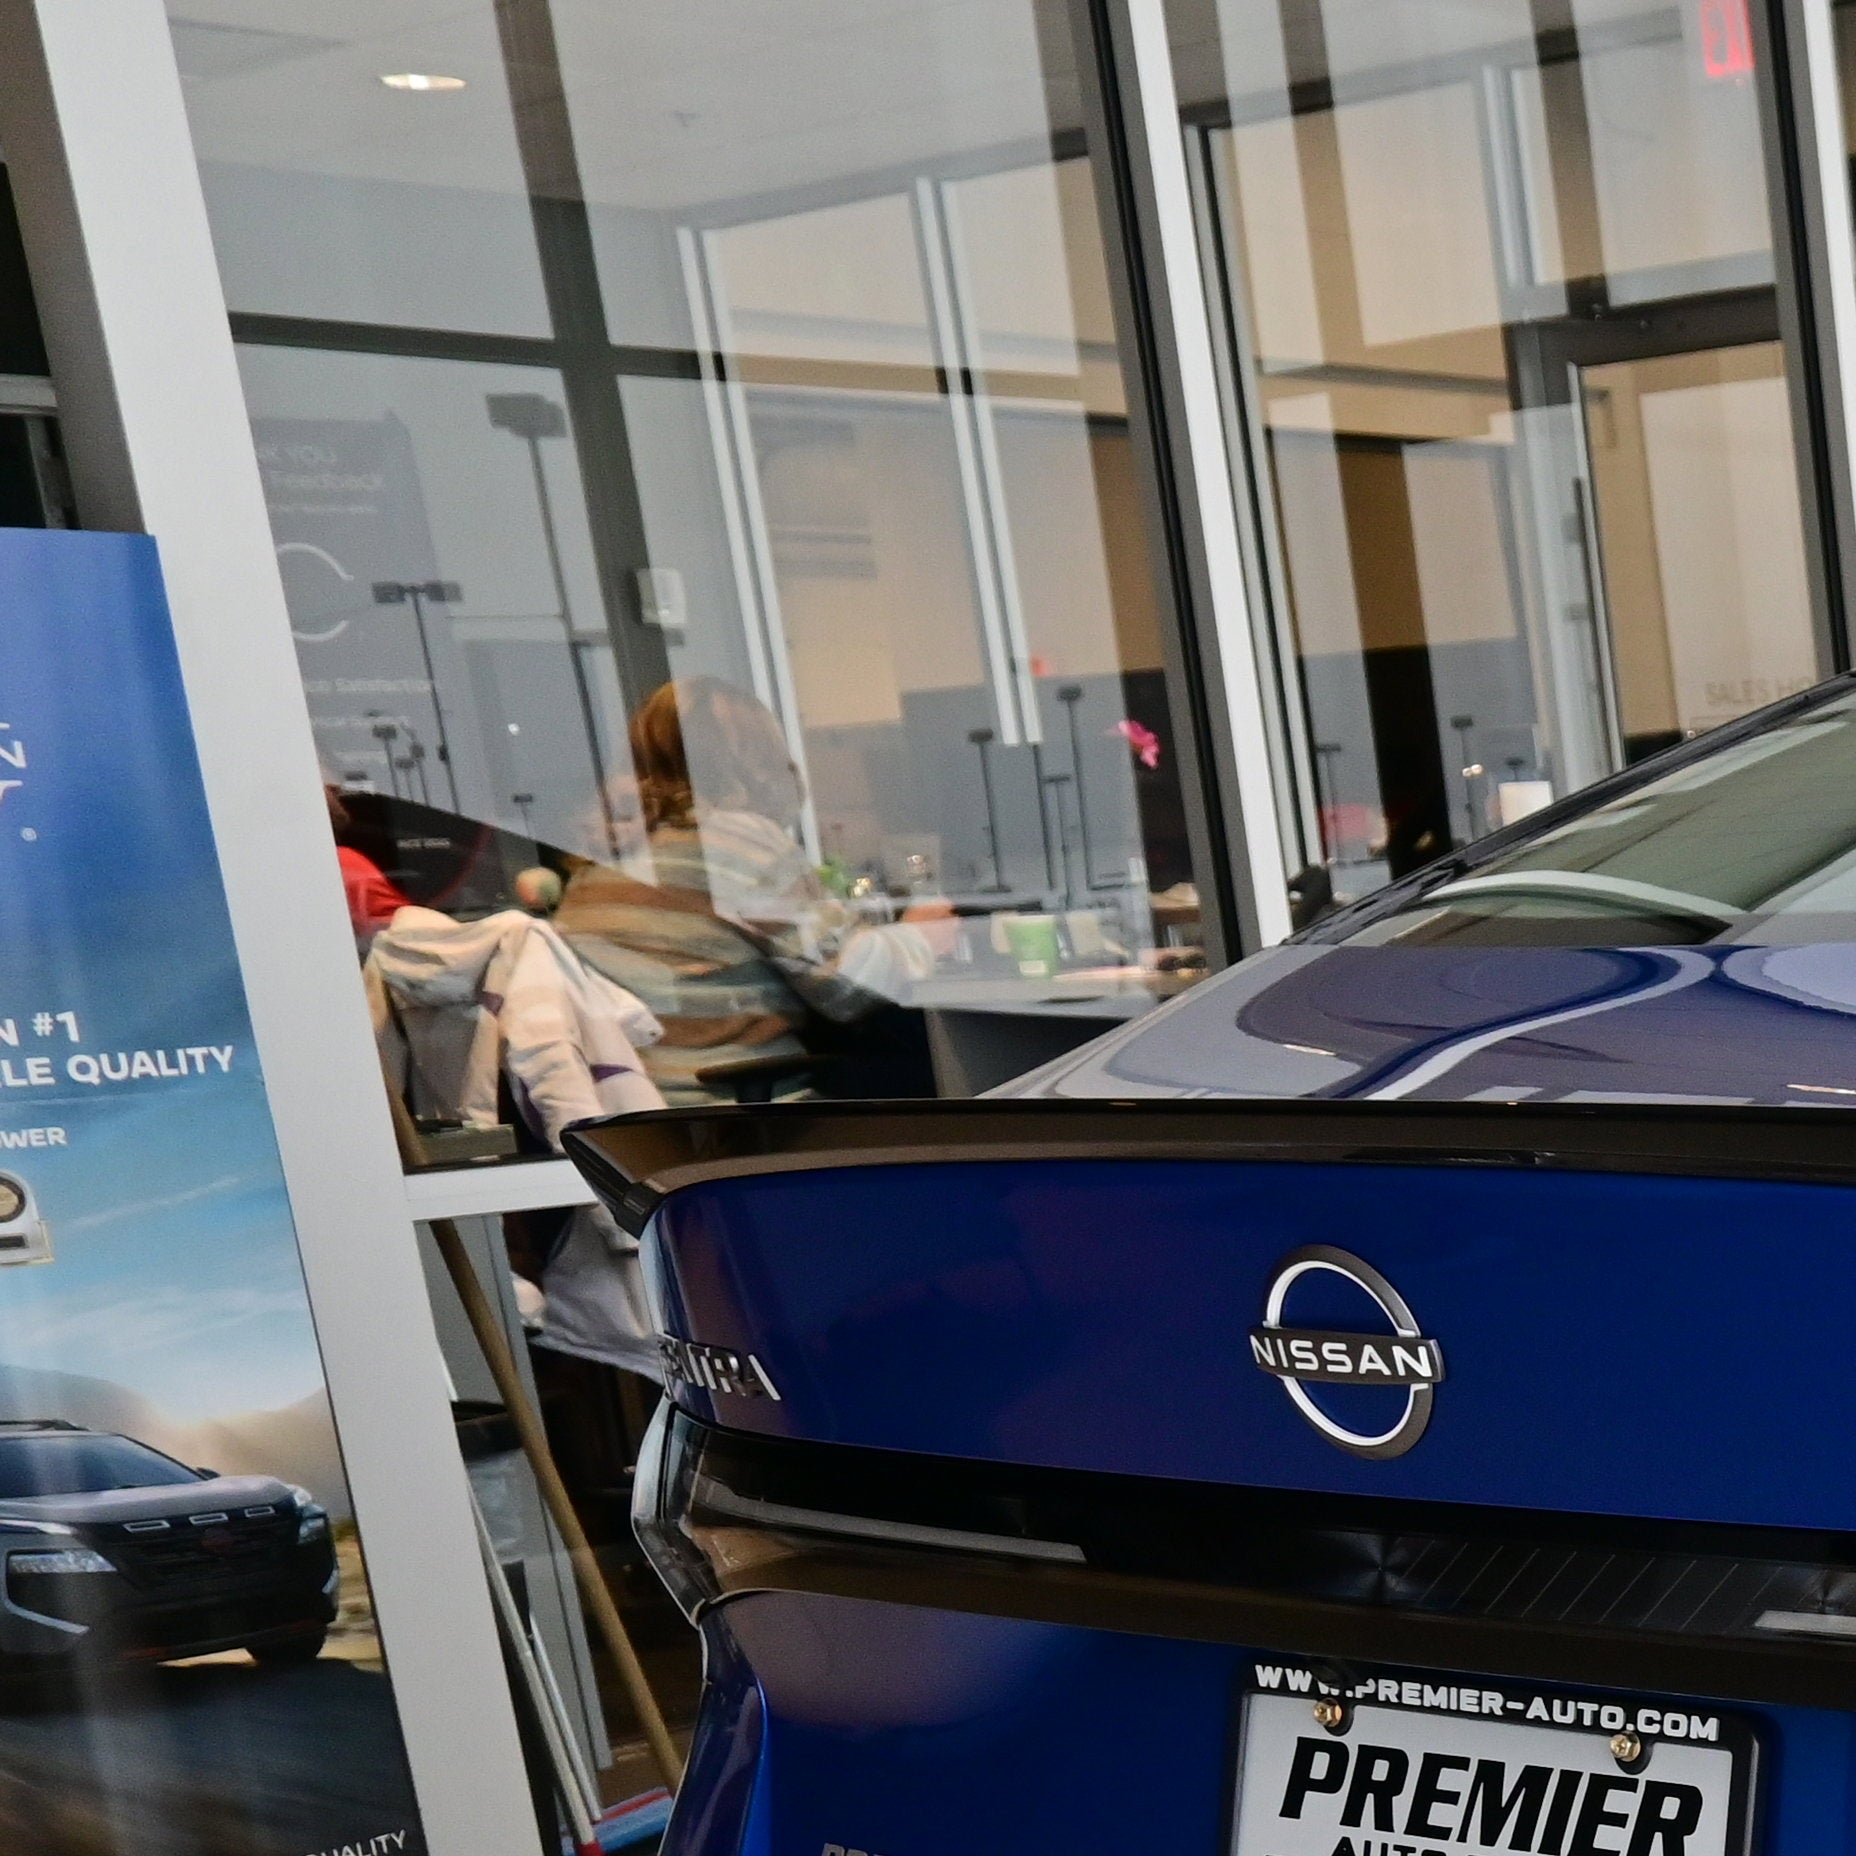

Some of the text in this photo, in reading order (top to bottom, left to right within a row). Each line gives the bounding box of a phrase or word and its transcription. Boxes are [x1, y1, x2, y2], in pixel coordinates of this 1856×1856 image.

[33, 1011, 80, 1043] #1
[0, 1045, 233, 1087] LE QUALITY
[0, 1127, 67, 1150] WER
[1250, 1335, 1433, 1378] NISSAN
